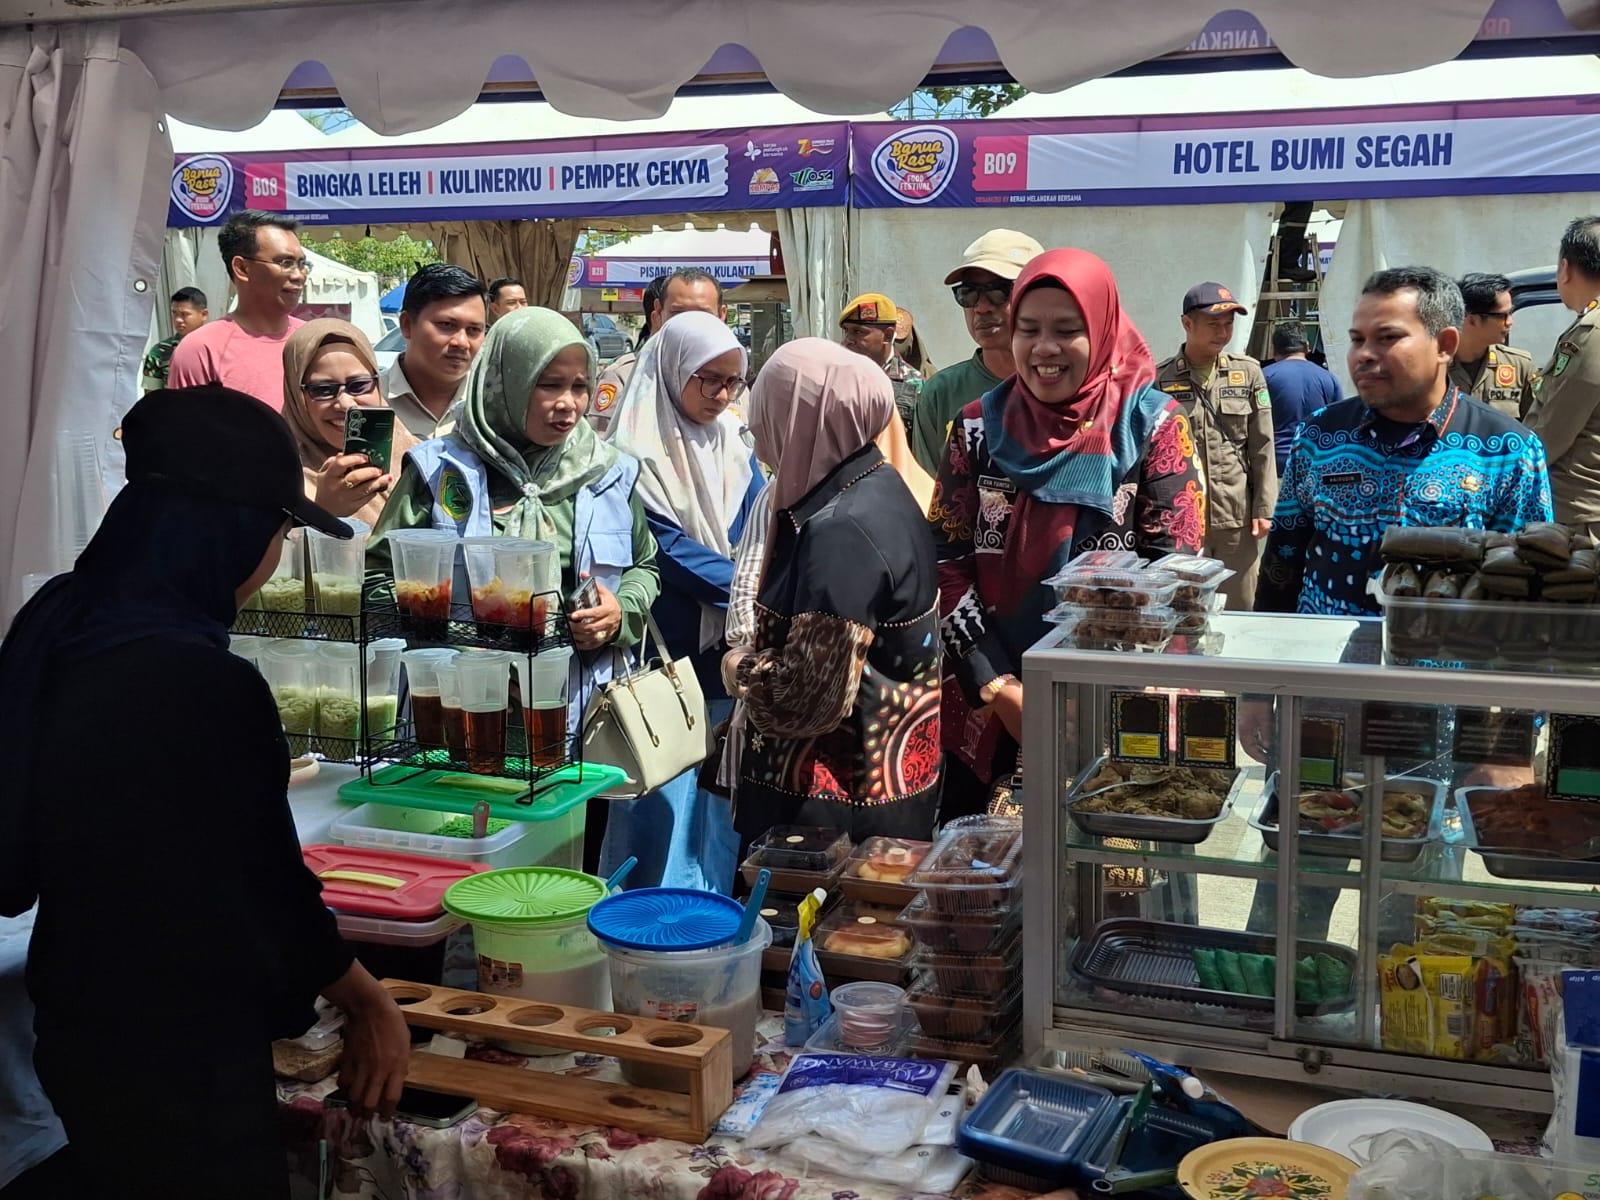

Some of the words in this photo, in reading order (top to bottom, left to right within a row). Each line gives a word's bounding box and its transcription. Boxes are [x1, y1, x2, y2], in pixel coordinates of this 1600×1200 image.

[890, 140, 943, 158] Banua
[1173, 140, 1260, 174] HOTEL
[1270, 137, 1345, 171] BUMI
[1355, 133, 1453, 167] SEGAH
[897, 154, 936, 173] Rasa
[984, 153, 1017, 175] B09
[182, 167, 221, 182] Banua
[297, 172, 363, 198] BINGKA
[368, 171, 421, 195] LELEH
[440, 167, 542, 195] KULINERKU
[561, 162, 640, 190] PEMPEK
[647, 158, 710, 186] CEKYA
[907, 175, 925, 183] FOOD
[188, 178, 216, 195] Rasa
[900, 182, 931, 191] FESTIVAL
[640, 266, 672, 278] PISANG
[714, 265, 756, 278] KULANTA
[1221, 389, 1236, 398] POL
[1490, 390, 1506, 399] POL
[803, 1058, 896, 1070] BAWANG
